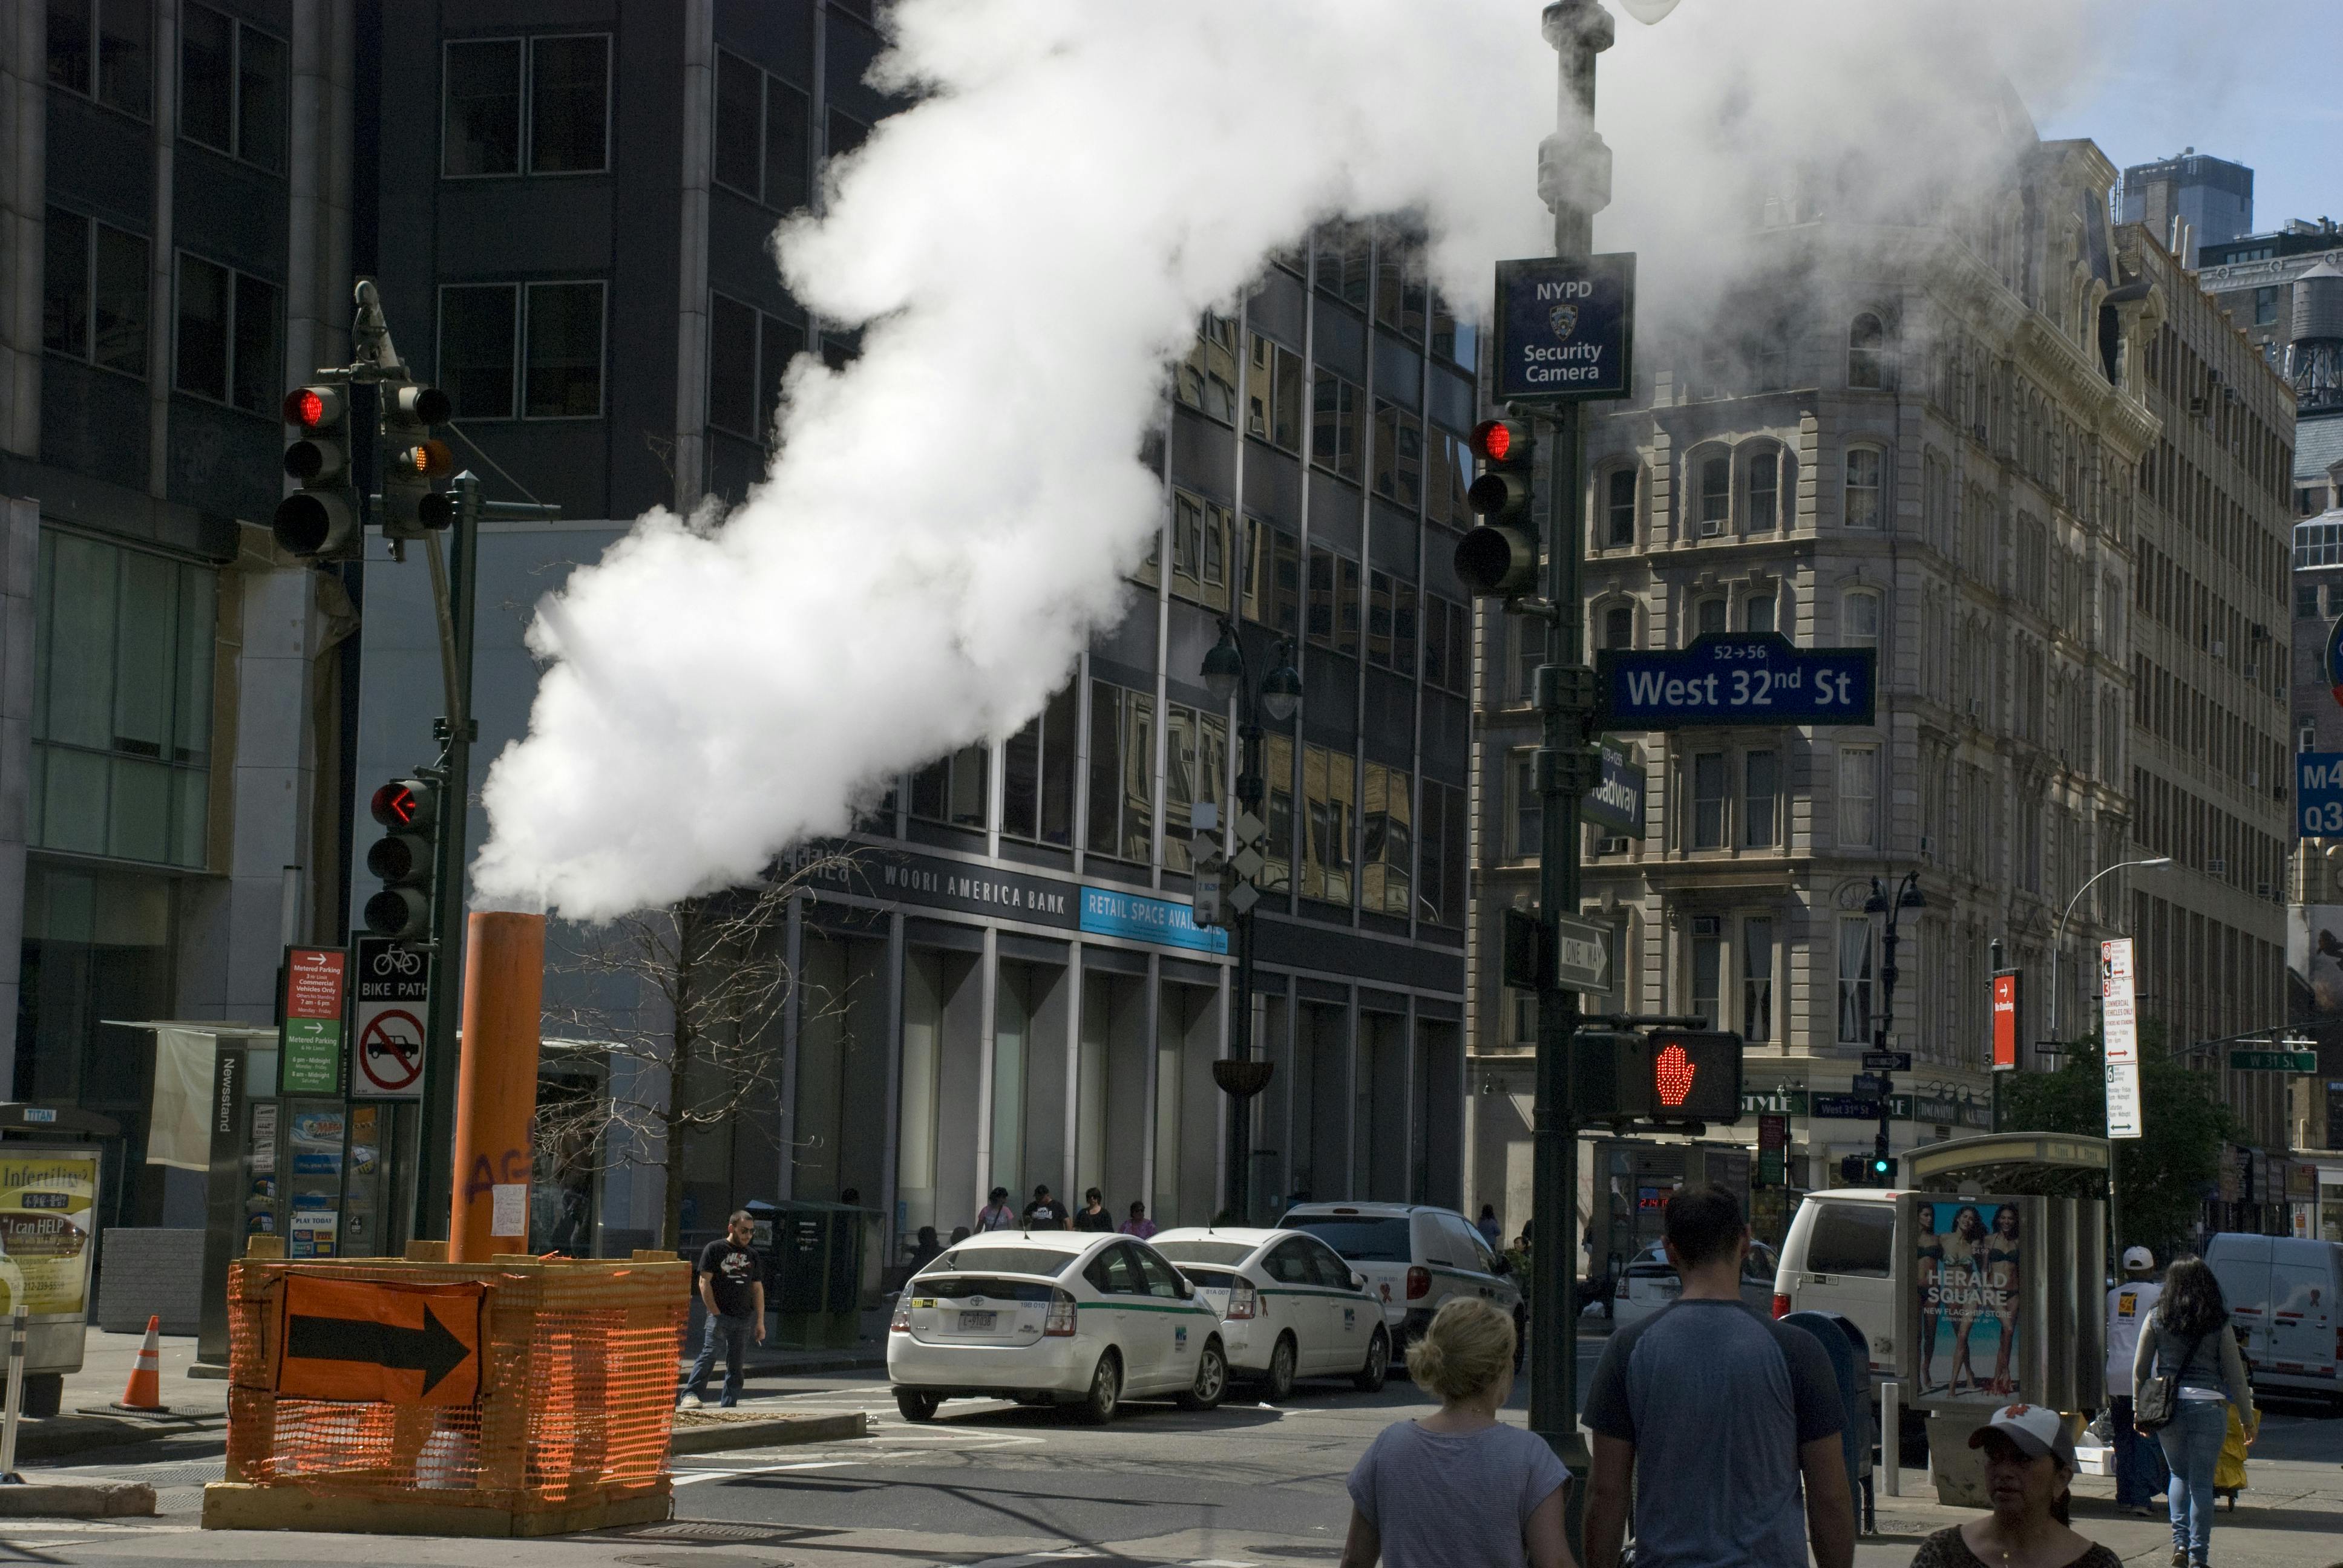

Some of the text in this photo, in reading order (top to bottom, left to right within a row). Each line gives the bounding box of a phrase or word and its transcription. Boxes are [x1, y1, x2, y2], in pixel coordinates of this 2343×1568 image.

[1537, 281, 1592, 301] NYPD
[1524, 341, 1602, 363] Security
[1525, 365, 1599, 382] Camera
[1627, 667, 1852, 706] West 32nd St
[885, 864, 1064, 915] WOORI AMERICA BANK
[1089, 893, 1127, 919] RETAIL
[1131, 902, 1165, 926] SPACE
[1566, 939, 1602, 969] ONE WAY
[319, 965, 341, 975] Parking
[362, 982, 428, 996] BIKE PATH
[2104, 981, 2110, 996] 3
[315, 1037, 337, 1046] Parking
[2250, 1055, 2261, 1067] W
[2107, 1066, 2113, 1082] 6
[220, 1058, 235, 1132] Newsstand
[27, 1109, 53, 1120] TITAN
[1821, 1105, 1843, 1114] West
[4, 1165, 88, 1187] Infertility?
[16, 1223, 36, 1234] can
[36, 1218, 64, 1234] HELP
[1928, 1269, 2008, 1288] HERALD
[1927, 1287, 2008, 1306] SQUARE
[1924, 1307, 2012, 1319] NEW FLAGSHIP STORE
